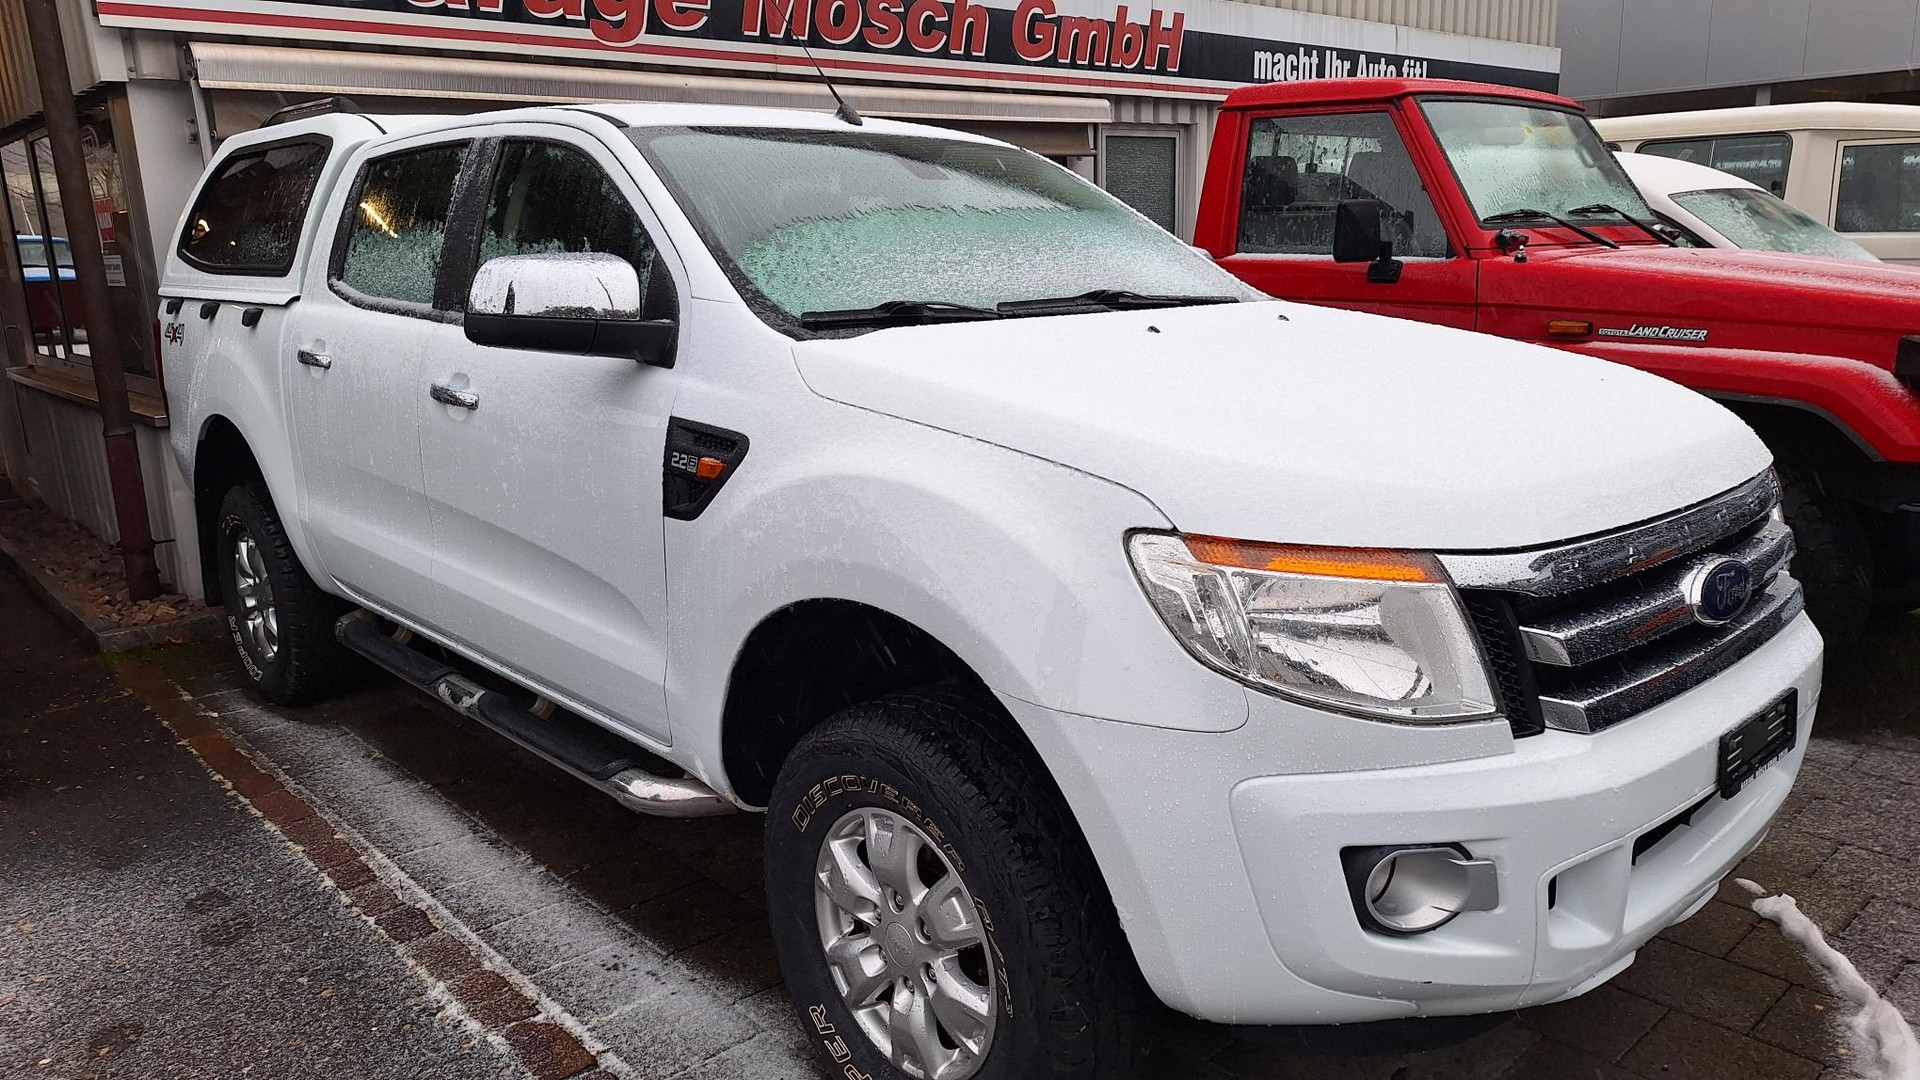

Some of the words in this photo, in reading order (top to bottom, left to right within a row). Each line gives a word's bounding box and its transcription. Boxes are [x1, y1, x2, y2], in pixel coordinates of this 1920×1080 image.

[1011, 0, 1185, 72] GmbH
[1253, 47, 1319, 81] macht
[1324, 50, 1350, 79] Ihr
[791, 774, 967, 872] DISCOVERER
